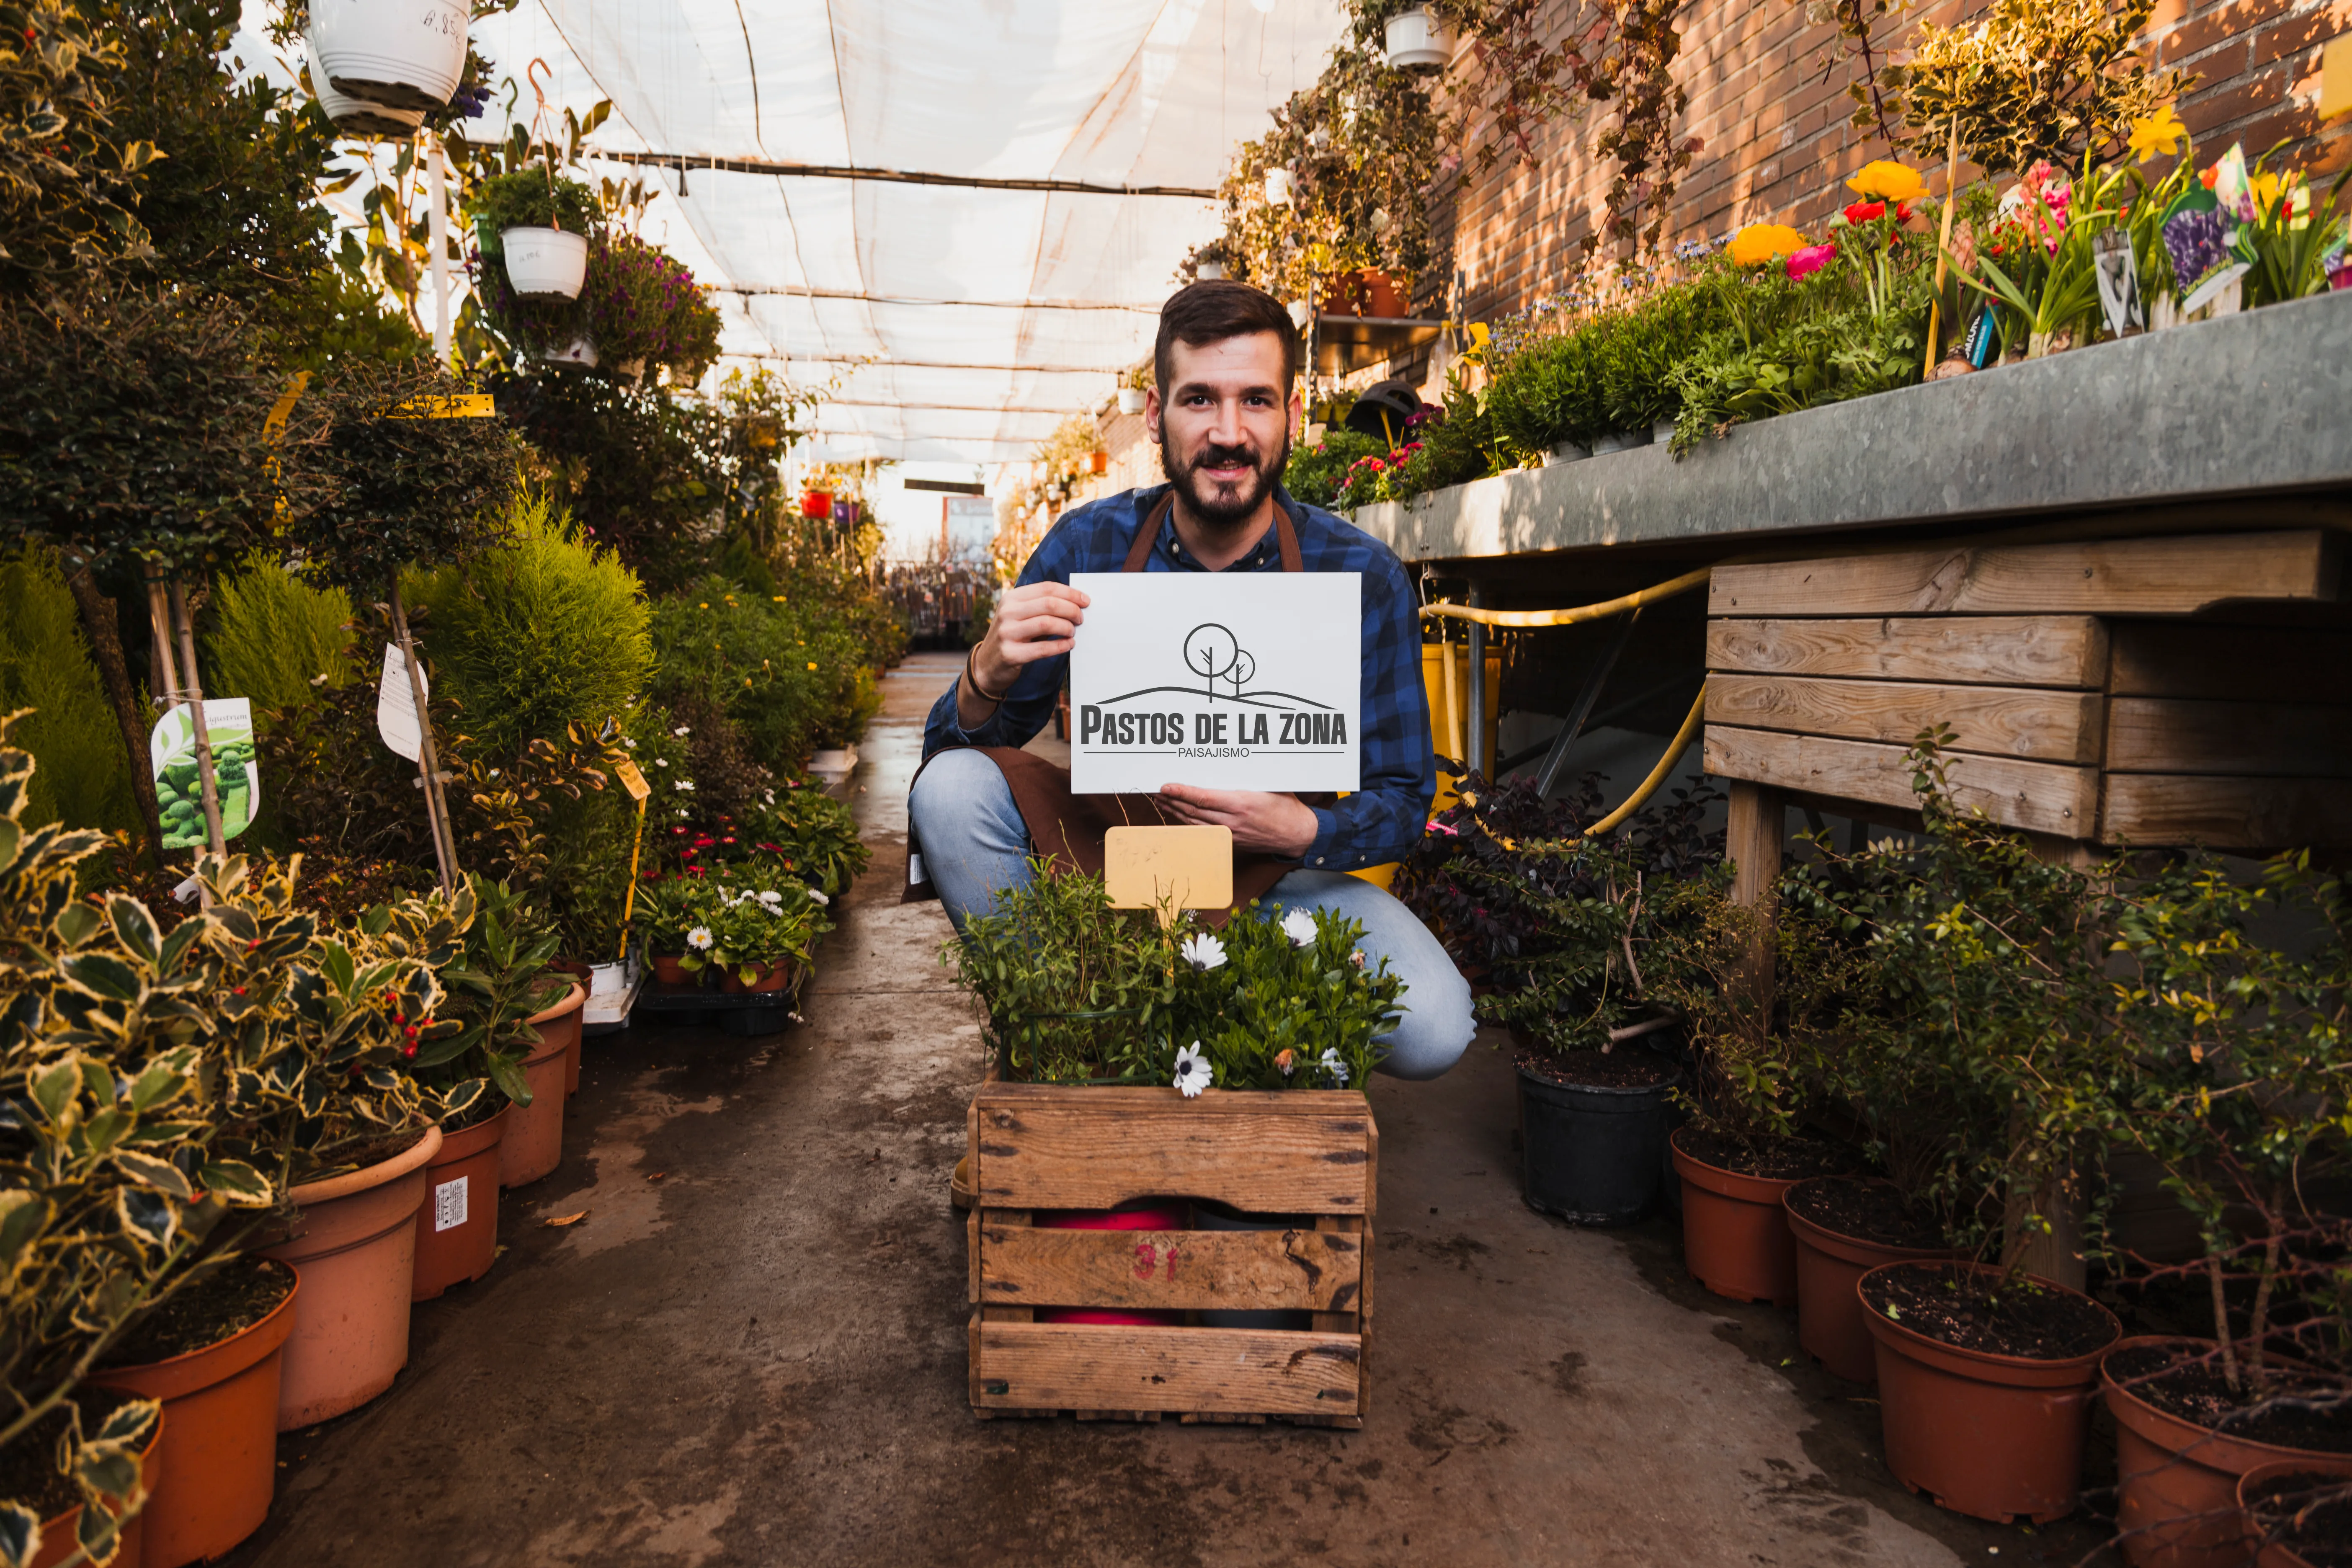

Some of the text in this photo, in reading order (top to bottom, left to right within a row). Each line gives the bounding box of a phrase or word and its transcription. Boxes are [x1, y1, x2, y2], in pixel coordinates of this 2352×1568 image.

[1081, 705, 1347, 745] PASTOS DE LA ZONA
[1178, 748, 1250, 757] PAISAJISMO
